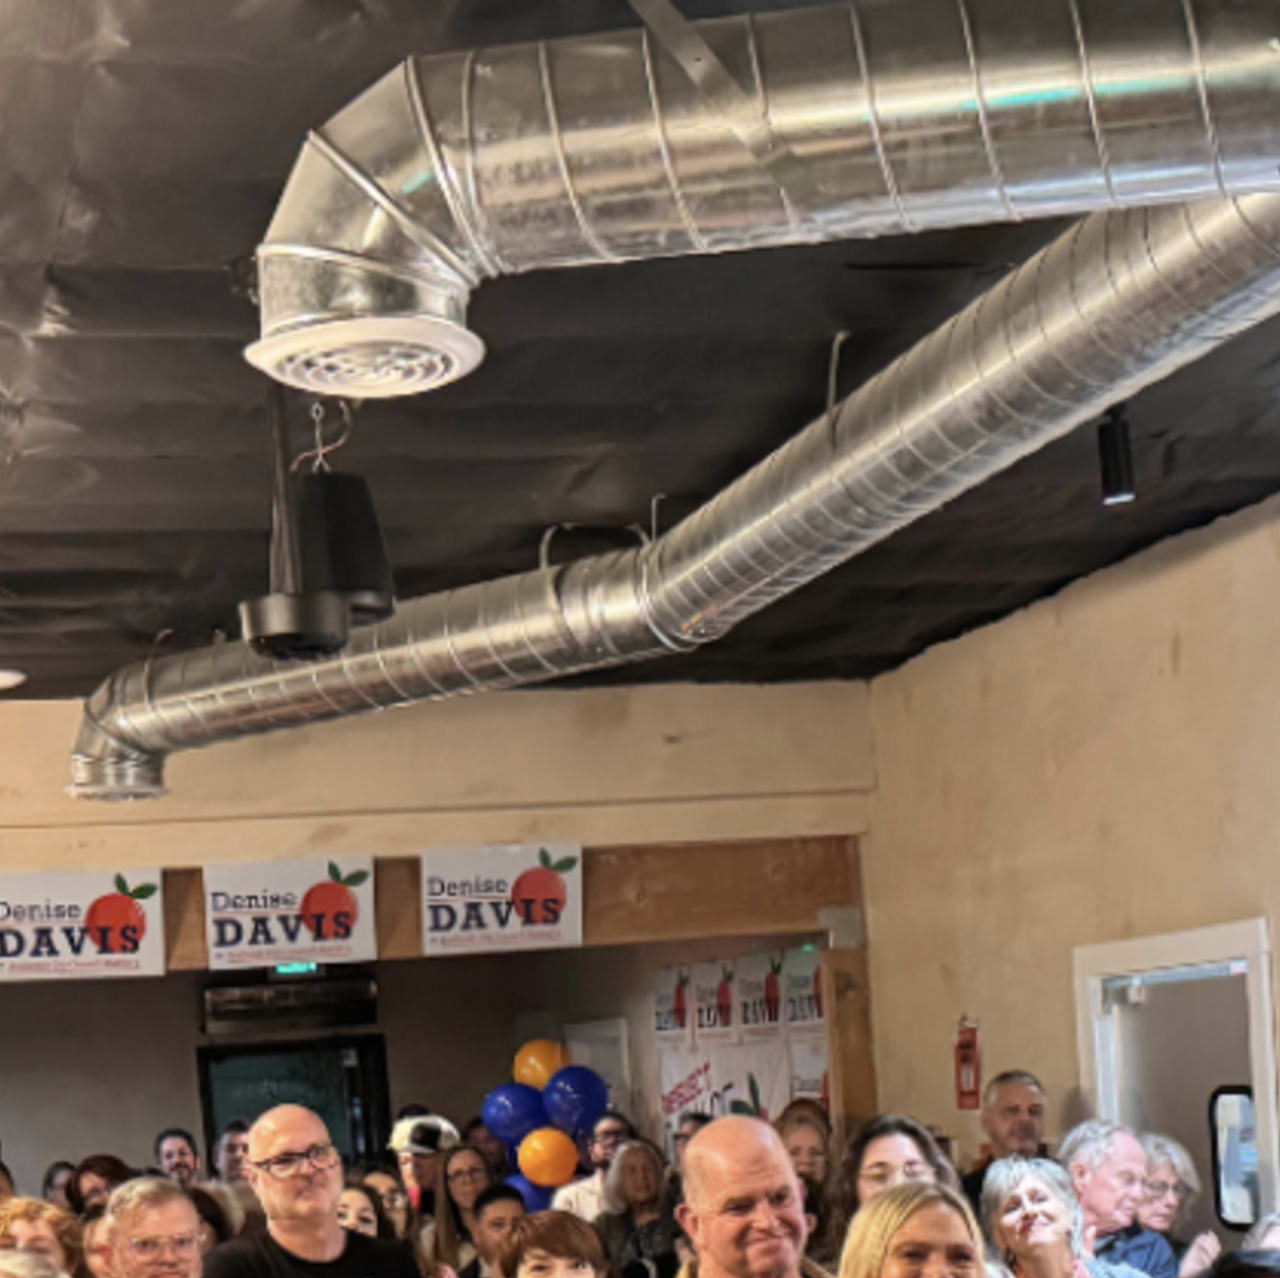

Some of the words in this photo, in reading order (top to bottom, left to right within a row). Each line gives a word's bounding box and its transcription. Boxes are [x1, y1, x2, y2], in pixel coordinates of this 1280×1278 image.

[426, 873, 508, 896] Denise
[211, 889, 297, 912] Denise
[428, 897, 562, 932] DAVIS
[213, 911, 353, 948] DAVIS
